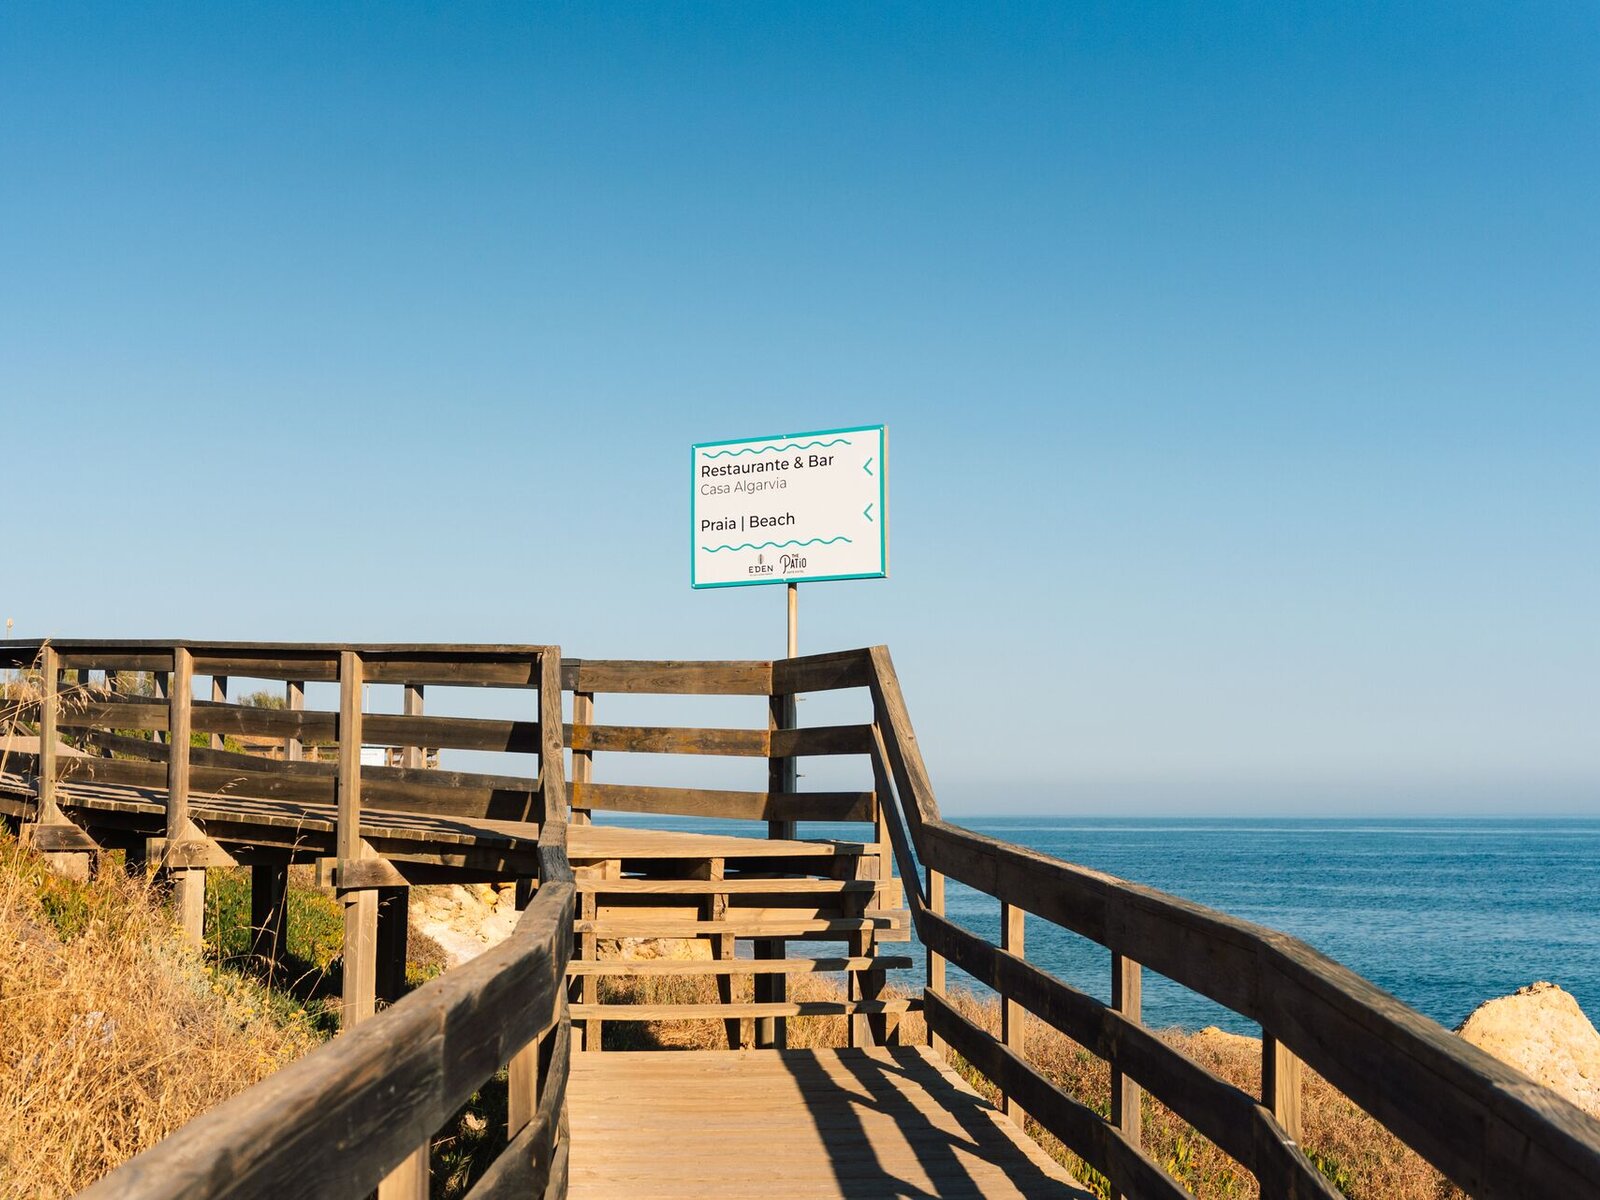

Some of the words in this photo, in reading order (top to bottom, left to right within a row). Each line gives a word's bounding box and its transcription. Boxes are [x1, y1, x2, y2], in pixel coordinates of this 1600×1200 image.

[701, 458, 790, 478] Restaurante
[794, 456, 804, 469] &
[808, 454, 834, 468] Bar
[700, 483, 731, 496] Casa
[734, 477, 787, 495] Algarvia
[701, 517, 737, 532] Praia
[749, 512, 795, 528] Beach
[748, 565, 774, 574] EDEN
